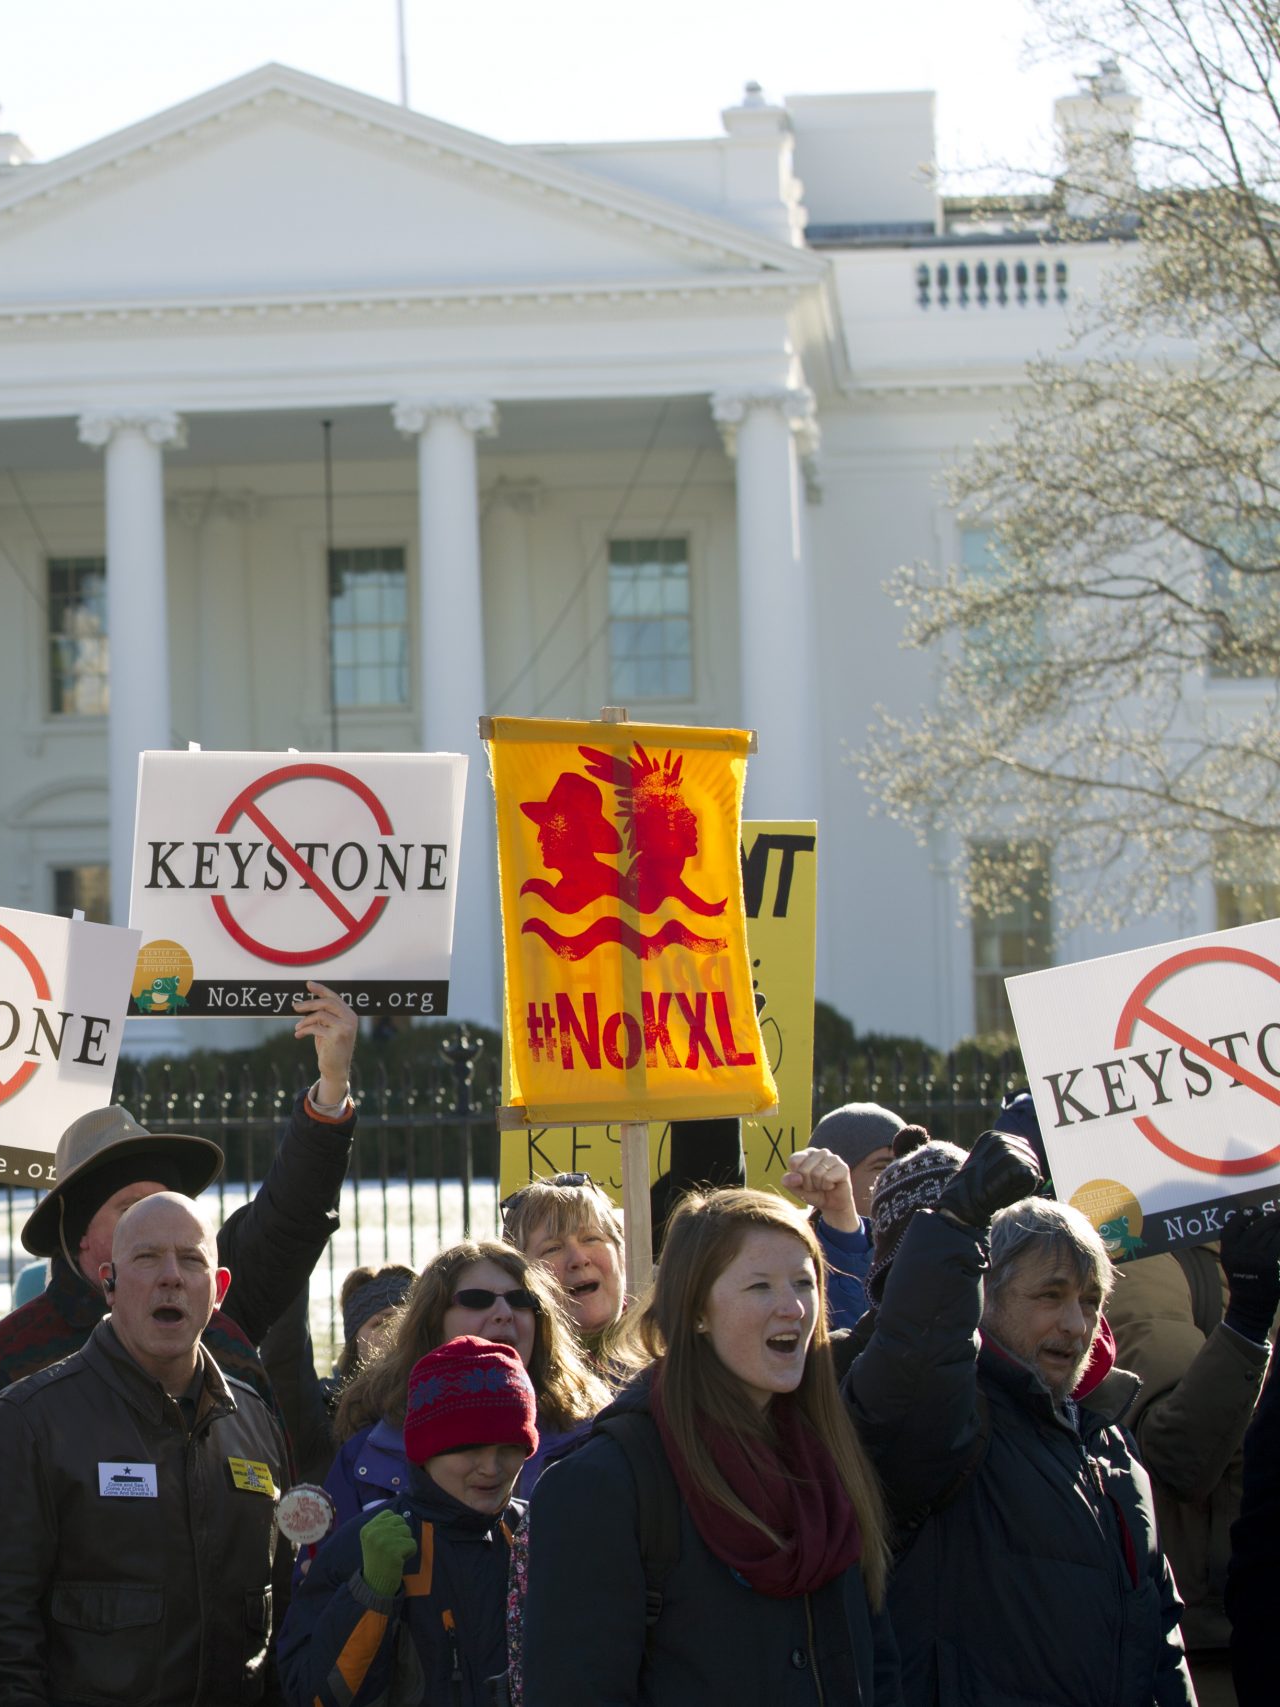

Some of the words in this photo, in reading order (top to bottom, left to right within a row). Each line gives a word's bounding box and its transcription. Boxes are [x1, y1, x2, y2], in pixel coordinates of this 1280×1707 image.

[144, 841, 448, 892] KEYSTONE
[208, 987, 434, 1013] NoKeysne.org
[527, 991, 757, 1070] #NoKXL
